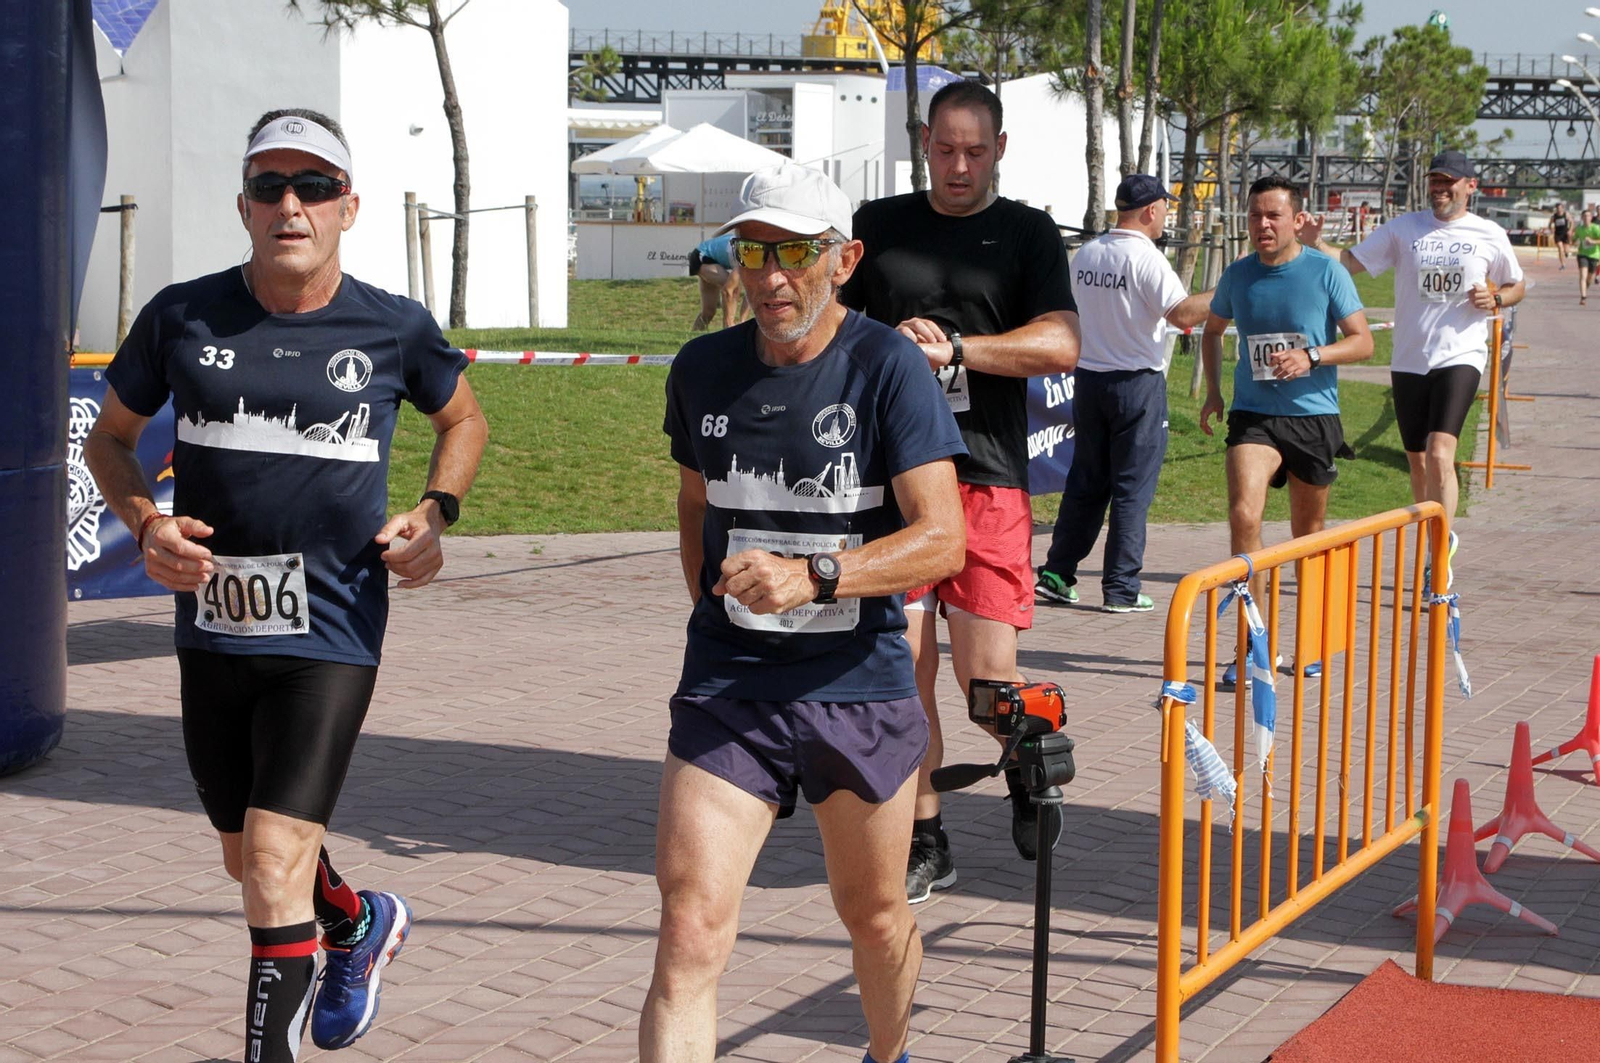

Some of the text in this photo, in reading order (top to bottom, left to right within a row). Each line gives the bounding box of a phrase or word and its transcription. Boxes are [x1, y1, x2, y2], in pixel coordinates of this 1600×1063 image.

[1412, 240, 1477, 255] RUTA 091
[1421, 255, 1460, 266] HUELVA
[1077, 269, 1127, 291] POLICIA
[1422, 272, 1462, 293] 4069
[199, 345, 235, 370] 33
[701, 413, 729, 438] 68
[266, 560, 286, 568] POLICI
[204, 572, 299, 623] 4006
[792, 608, 845, 618] DEPORTIVA
[200, 620, 306, 634] AGRUPACIÓN DEPORTIA
[779, 619, 794, 628] 4012
